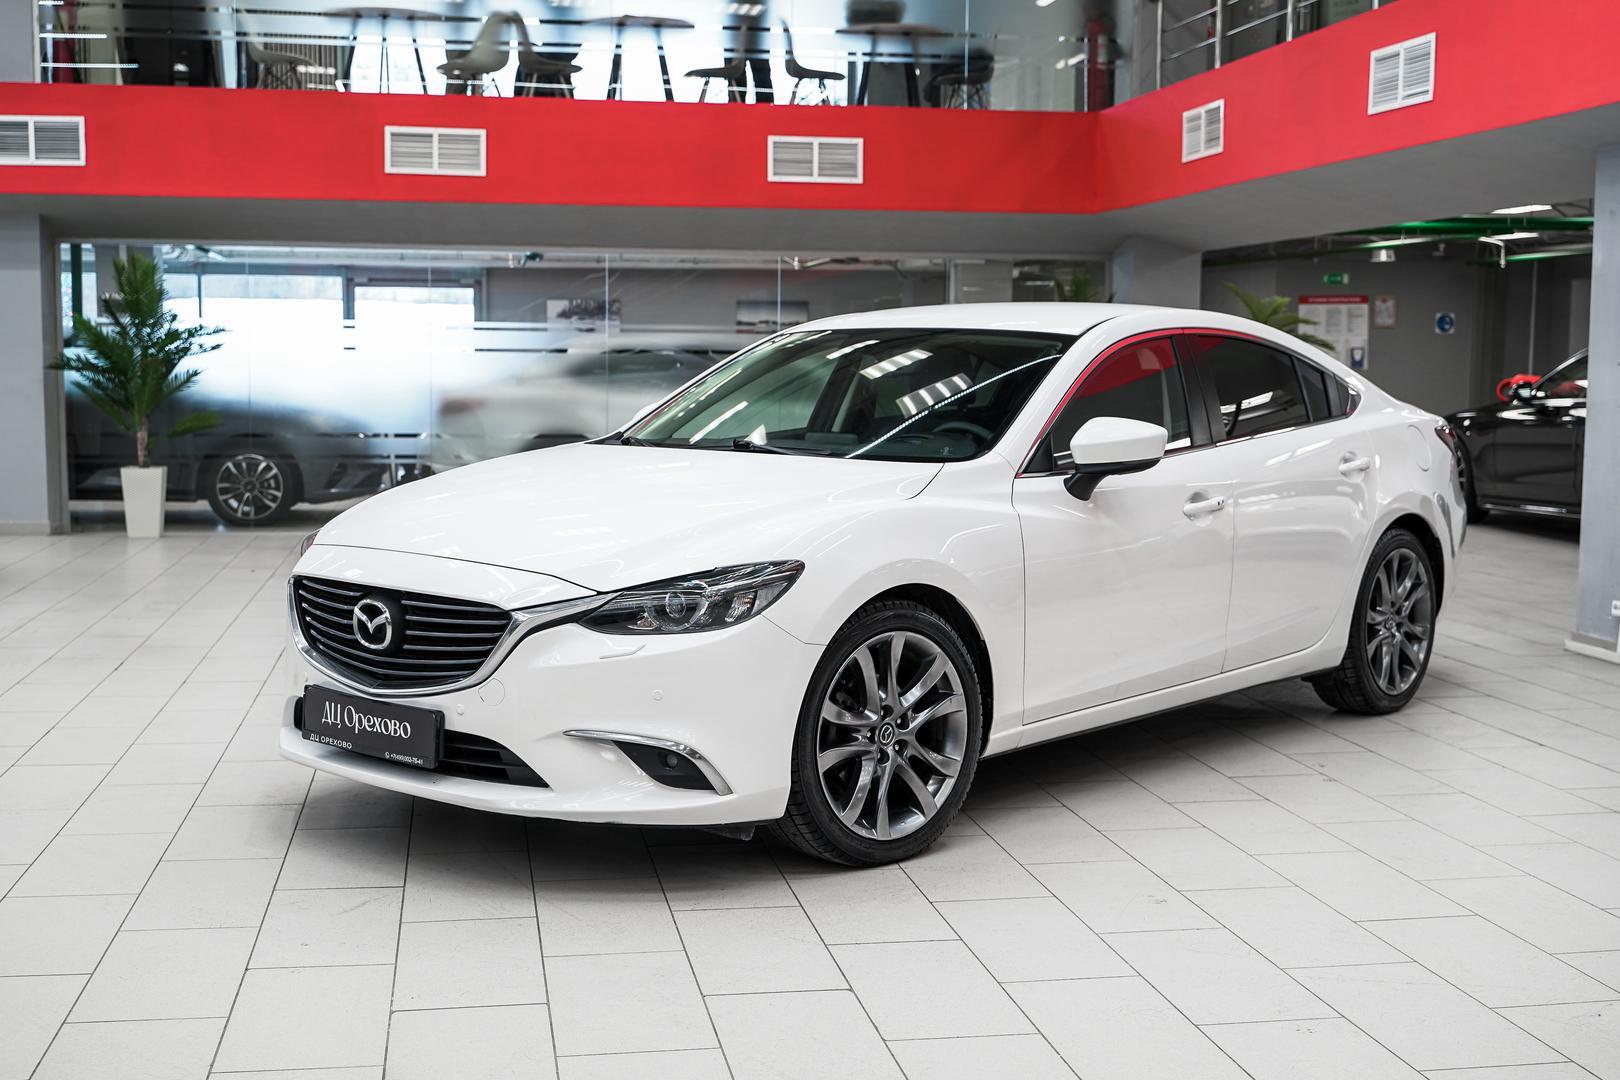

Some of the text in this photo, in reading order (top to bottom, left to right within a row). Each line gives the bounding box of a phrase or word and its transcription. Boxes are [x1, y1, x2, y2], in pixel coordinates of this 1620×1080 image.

[321, 701, 411, 739] ДЦ Орехово
[310, 733, 352, 749] ДЦ ОРЕХОВО
